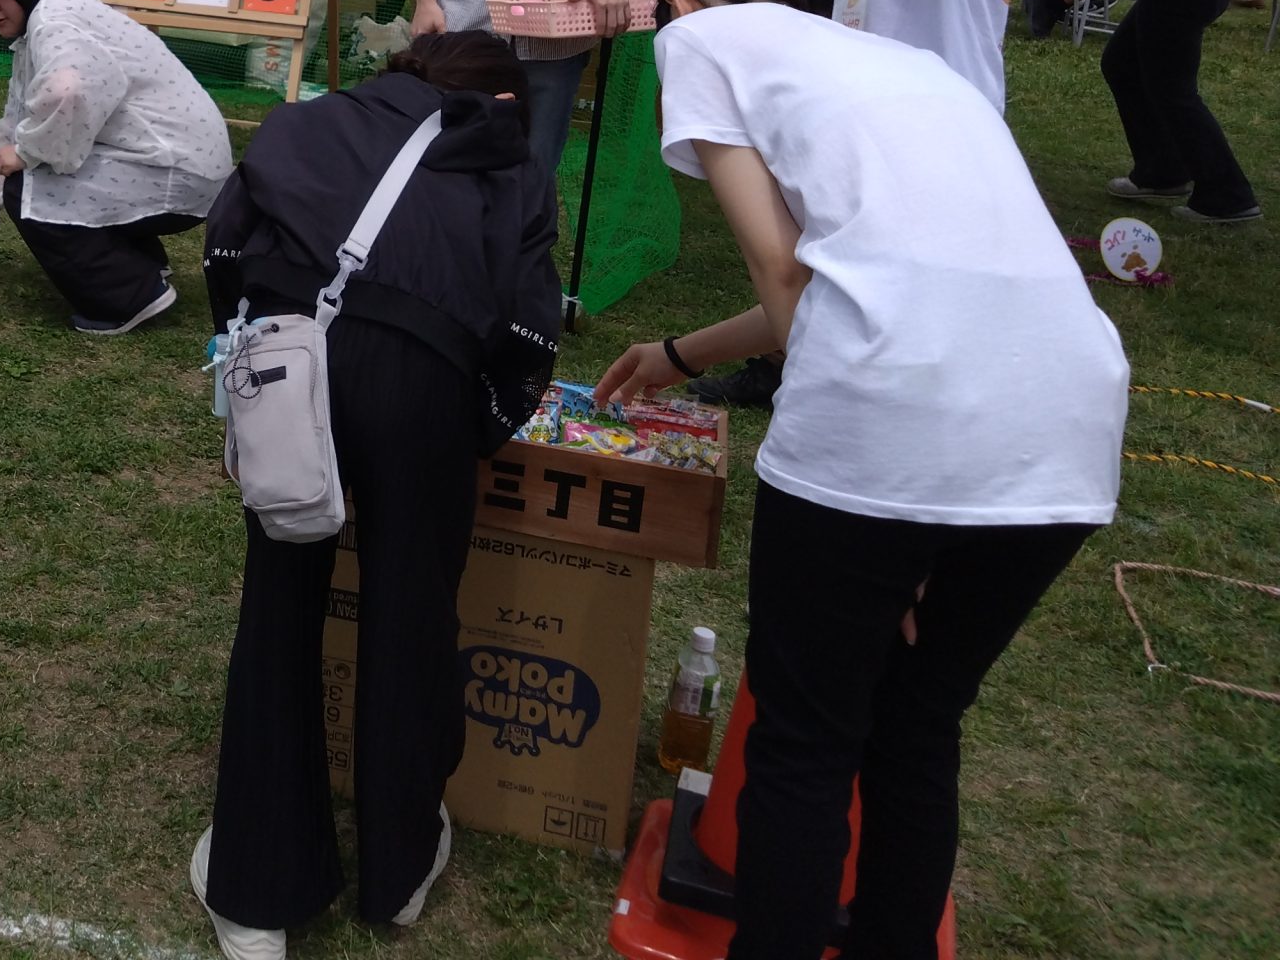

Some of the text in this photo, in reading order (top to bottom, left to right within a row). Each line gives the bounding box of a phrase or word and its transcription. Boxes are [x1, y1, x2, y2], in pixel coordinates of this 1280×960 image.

[484, 460, 645, 533] 三丁目
[496, 606, 564, 634] Lサイズ
[470, 651, 575, 704] Poko
[464, 679, 587, 744] Mamy
